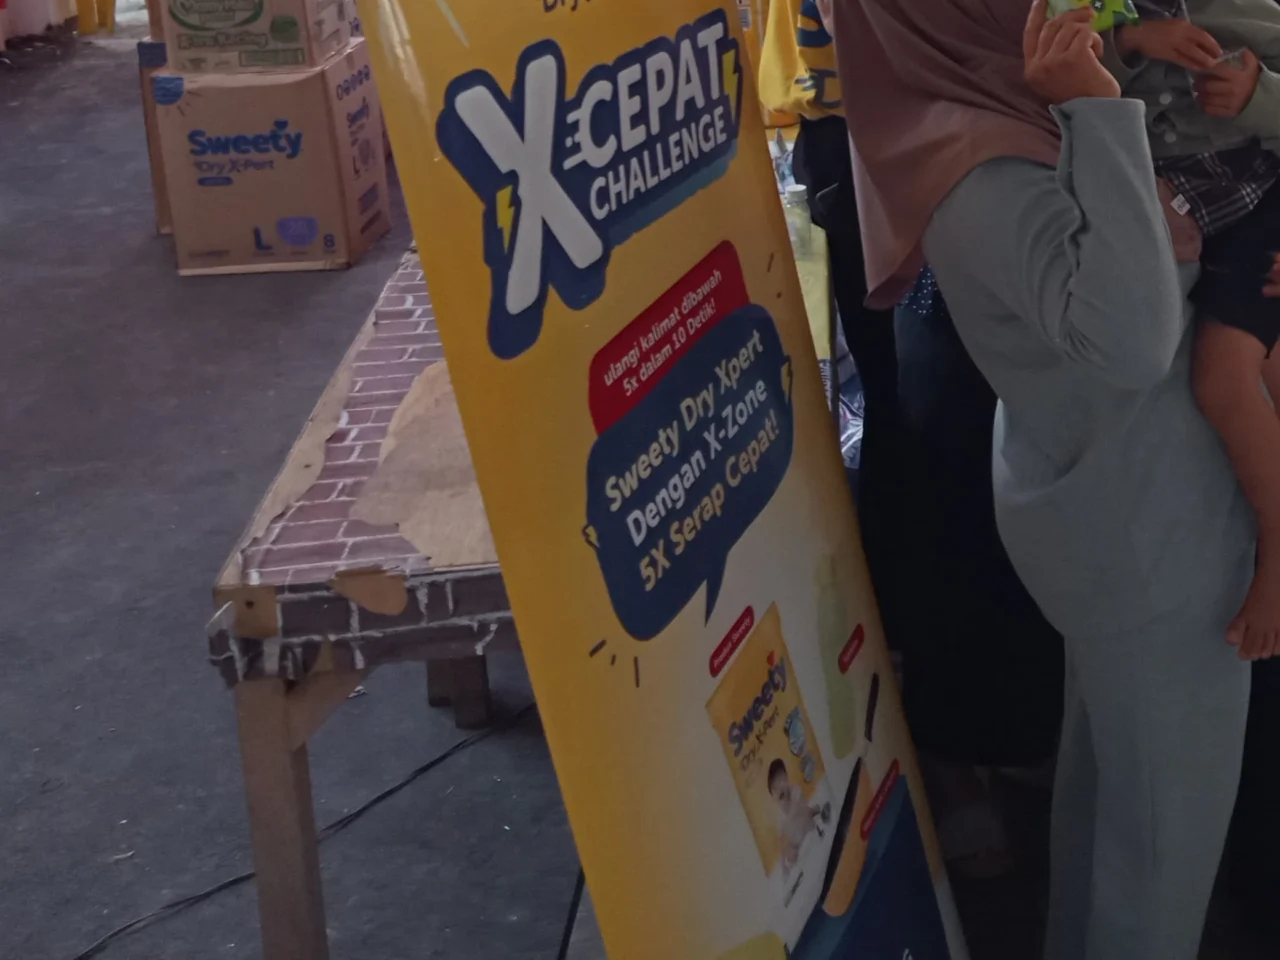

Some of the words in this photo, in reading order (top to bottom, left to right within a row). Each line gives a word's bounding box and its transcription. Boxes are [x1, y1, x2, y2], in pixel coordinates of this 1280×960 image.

[188, 126, 303, 159] Sweety
[590, 105, 727, 221] CHALLENGE
[253, 226, 273, 251] L
[603, 342, 641, 386] ulangi
[641, 306, 681, 353] kalimat
[681, 269, 722, 314] dibawah
[622, 377, 639, 397] 5x
[639, 343, 673, 381] dalam
[672, 327, 686, 350] 10
[688, 298, 717, 335] Detik!
[605, 420, 679, 512] Sweety
[680, 383, 715, 432] Dry
[714, 329, 764, 394] Xpert
[626, 450, 706, 547] Dengan
[703, 379, 768, 460] X-Zone
[639, 538, 671, 592] 5X
[669, 482, 725, 556] Serap
[725, 409, 780, 488] Cepat!
[728, 657, 787, 758] Sweety
